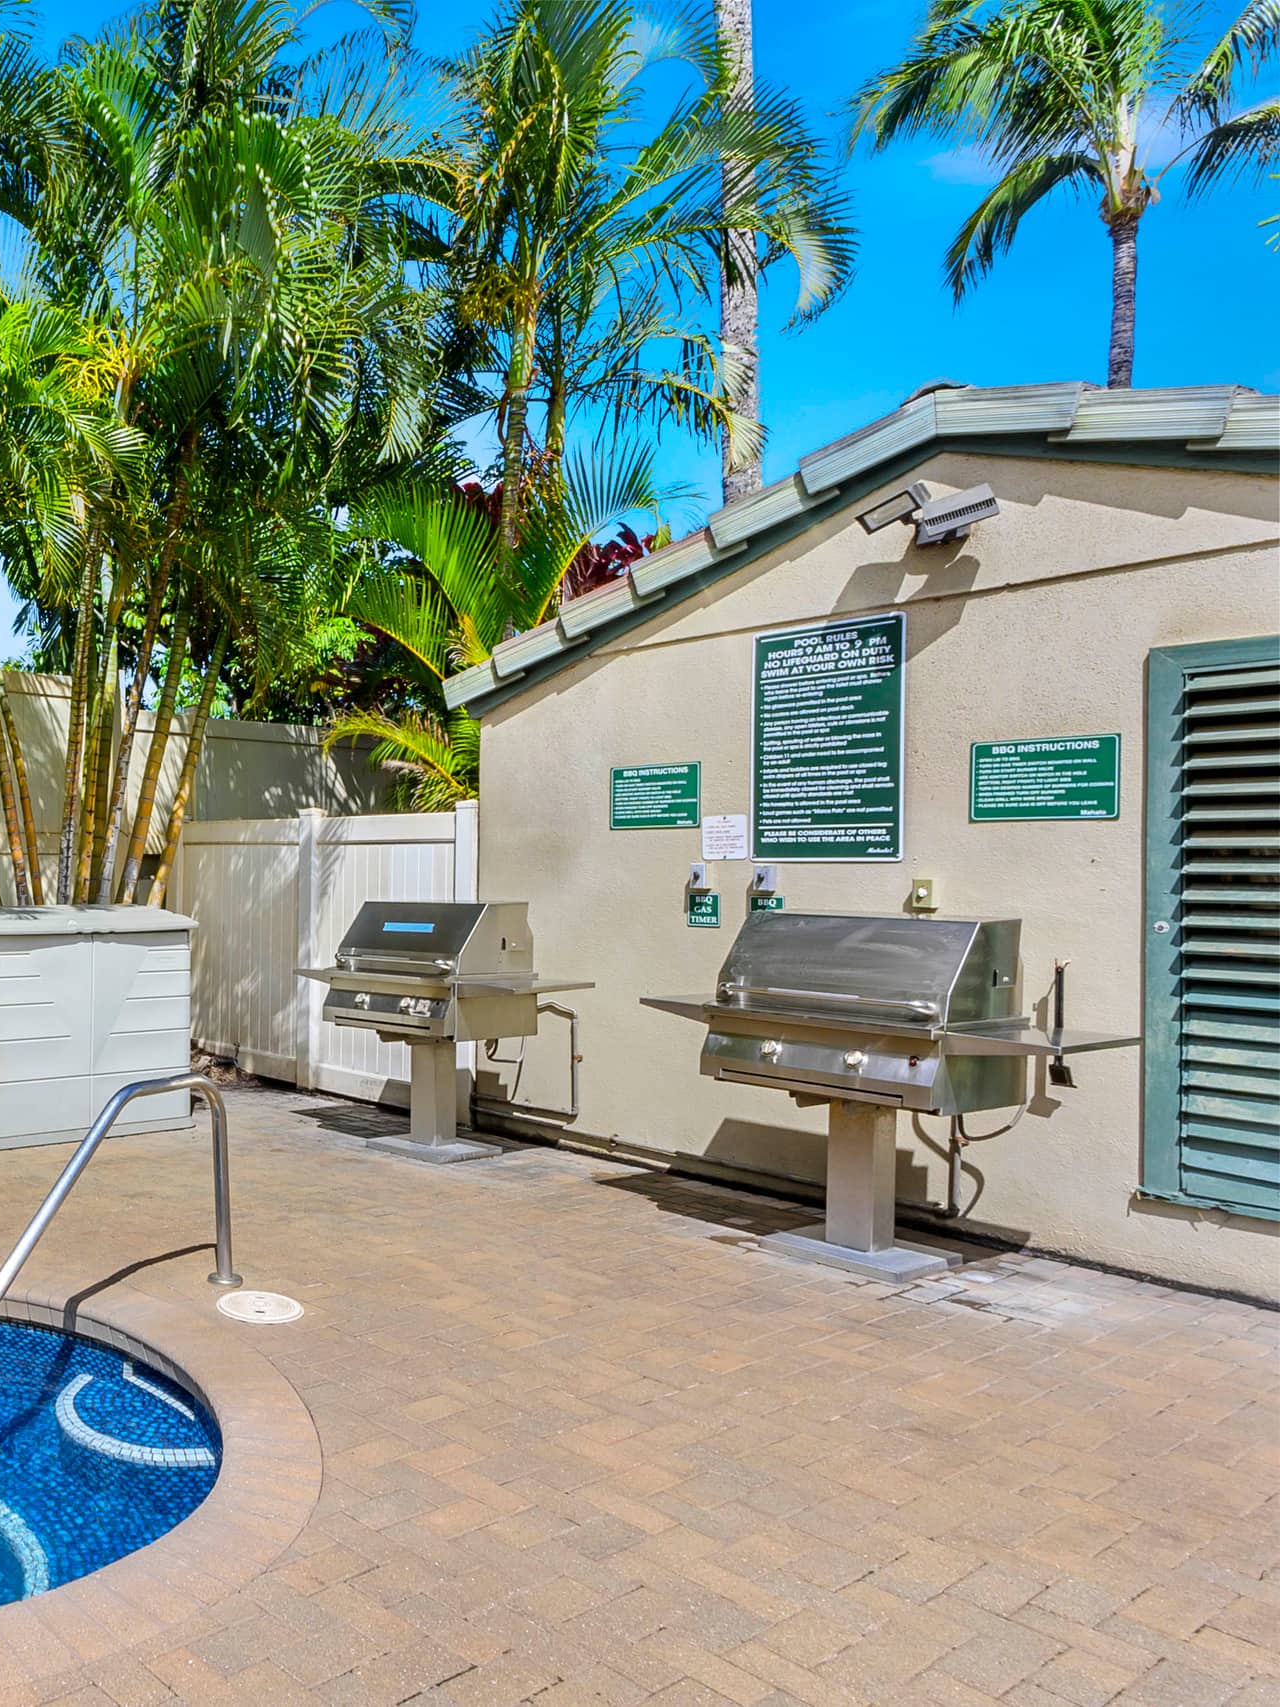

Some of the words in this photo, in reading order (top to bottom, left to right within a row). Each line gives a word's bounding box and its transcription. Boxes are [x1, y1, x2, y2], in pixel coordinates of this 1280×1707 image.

[794, 637, 823, 648] POOL
[826, 631, 858, 643] RULES
[768, 648, 804, 660] HOURS
[806, 646, 813, 654] 9
[814, 645, 833, 654] AM
[835, 642, 850, 651] TO
[855, 640, 862, 649] 9
[869, 636, 887, 646] PM
[764, 660, 780, 669] NO
[782, 652, 838, 668] LIFEGUARD
[841, 649, 859, 658] ON
[862, 645, 892, 656] DUTY
[761, 668, 789, 679] SWIM
[790, 665, 806, 675] AT
[806, 662, 836, 673] YOUR
[838, 658, 866, 668] OWN
[868, 654, 895, 665] RISK
[992, 746, 1016, 755] BBQ
[1017, 740, 1100, 753] INSTRUCTIONS
[639, 766, 688, 776] INSTRUCTIONS
[696, 896, 713, 904] BBQ
[758, 899, 777, 907] BBQ
[690, 916, 717, 924] TIMER
